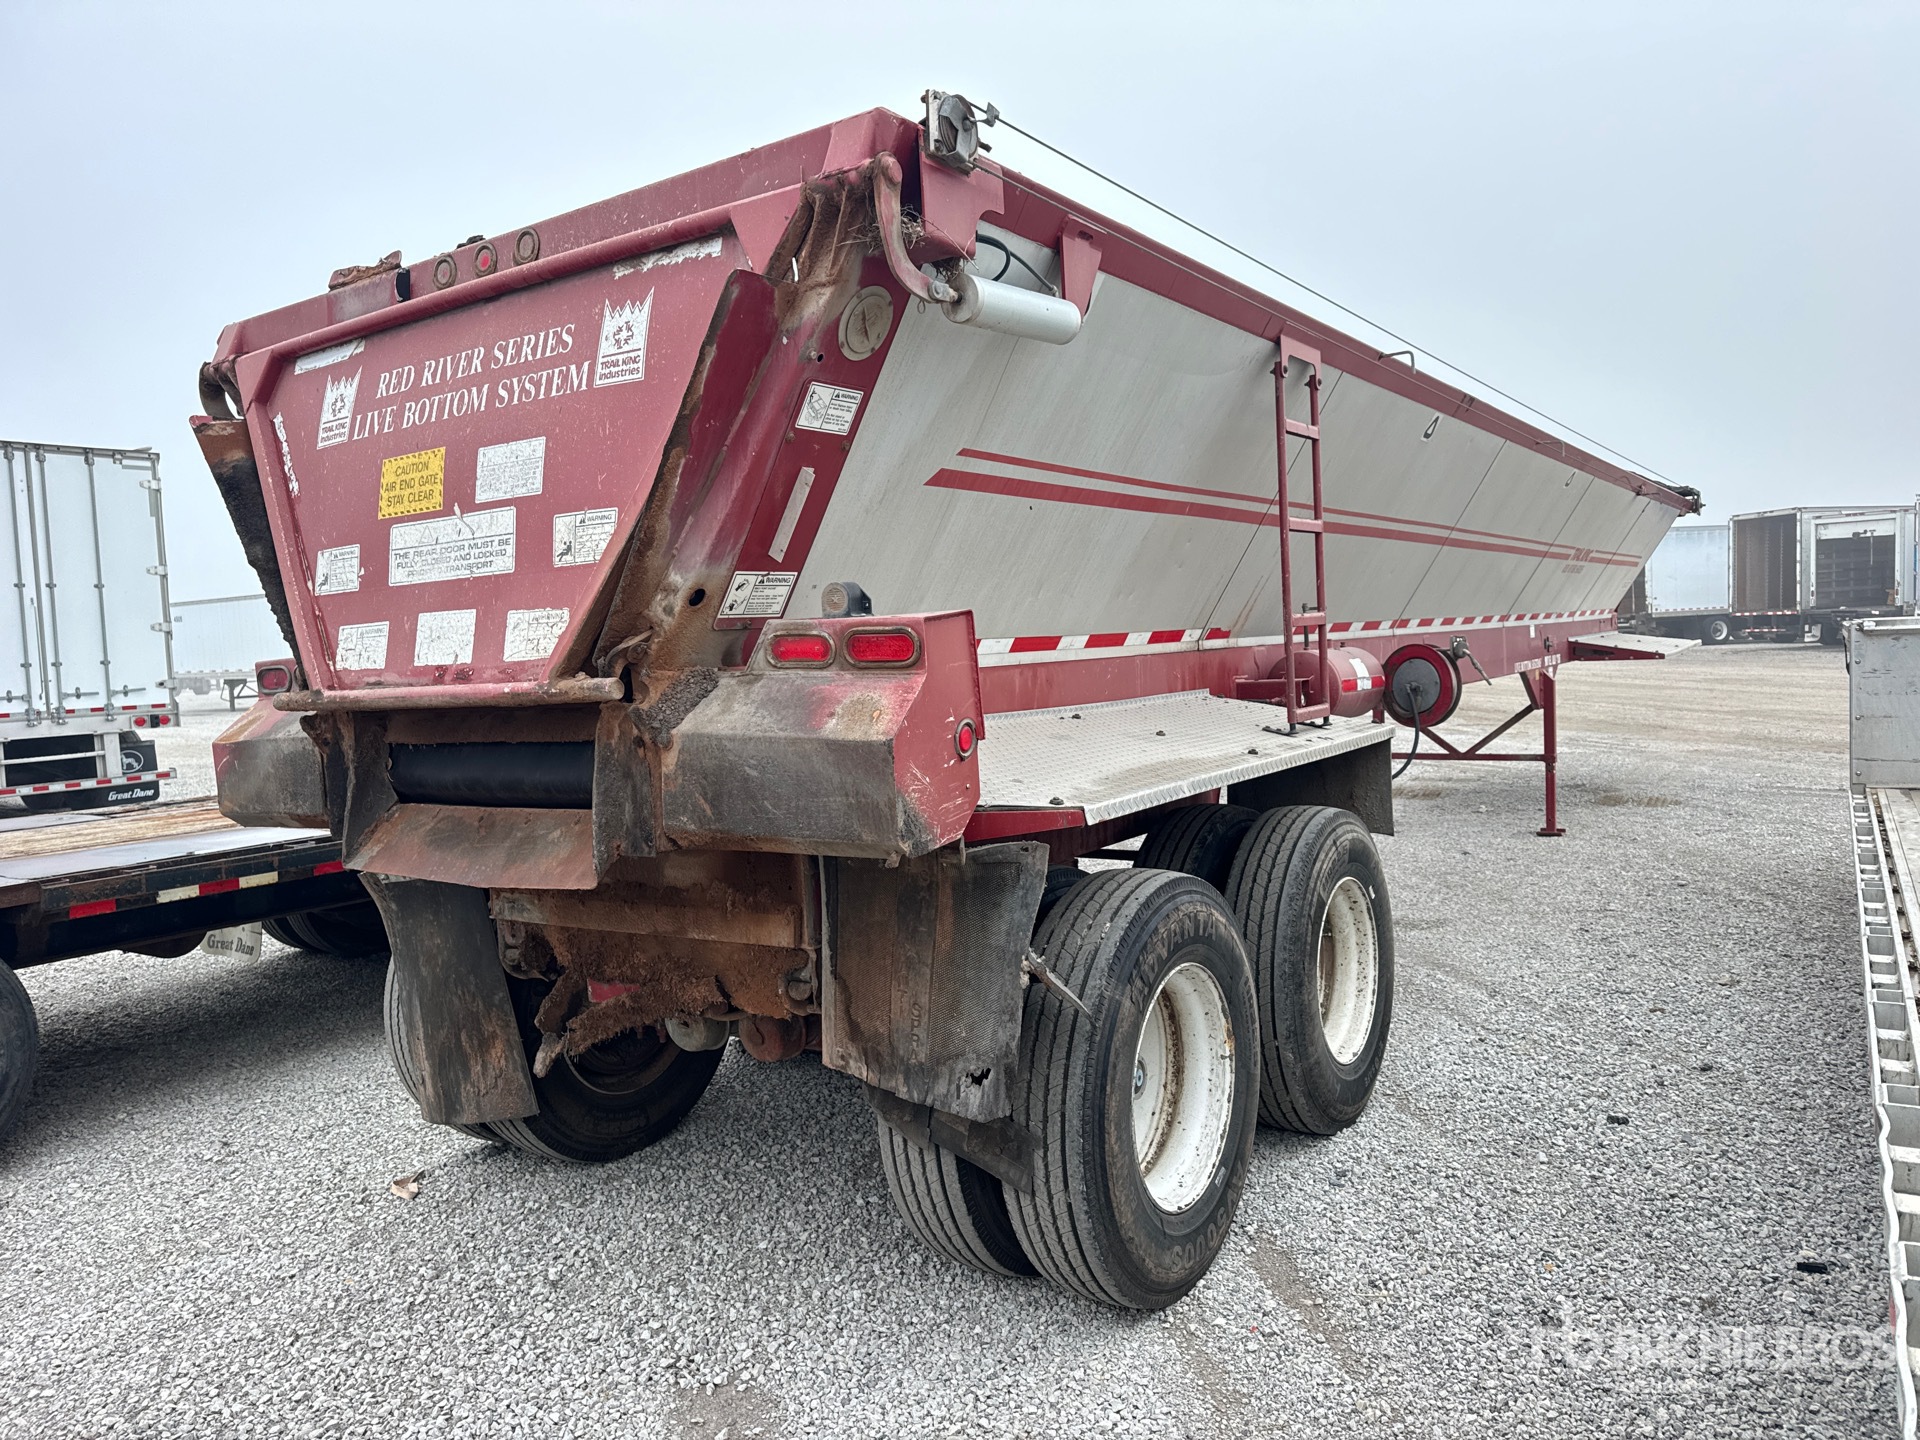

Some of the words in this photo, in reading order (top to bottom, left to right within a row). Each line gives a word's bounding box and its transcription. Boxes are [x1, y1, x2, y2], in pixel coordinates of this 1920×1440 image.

[375, 365, 415, 399] RED
[420, 346, 485, 388] RIVER
[490, 323, 576, 370] SERIES
[598, 366, 640, 381] industries
[351, 406, 397, 441] LIVE
[401, 383, 490, 429] BOTTOM
[495, 360, 592, 408] SYSTEM
[395, 460, 429, 477] CAUTION
[384, 481, 397, 493] AIR
[399, 478, 416, 491] END
[418, 473, 439, 487] GATE
[386, 494, 405, 508] STAY
[408, 489, 435, 503] CLEAR
[586, 513, 612, 522] WARNING
[394, 551, 410, 561] THE
[413, 547, 438, 560] REAR
[440, 543, 466, 556] DOOR
[468, 540, 495, 550] MUST
[498, 537, 511, 547] BE
[397, 560, 419, 570] FULLY
[453, 551, 471, 563] AND
[474, 548, 507, 559] LOCKED
[445, 560, 494, 574] TRANSPORT
[765, 576, 791, 584] WARNING
[108, 791, 132, 801] Great
[132, 788, 155, 798] Dane
[206, 933, 234, 951] Great
[234, 936, 255, 956] Dane
